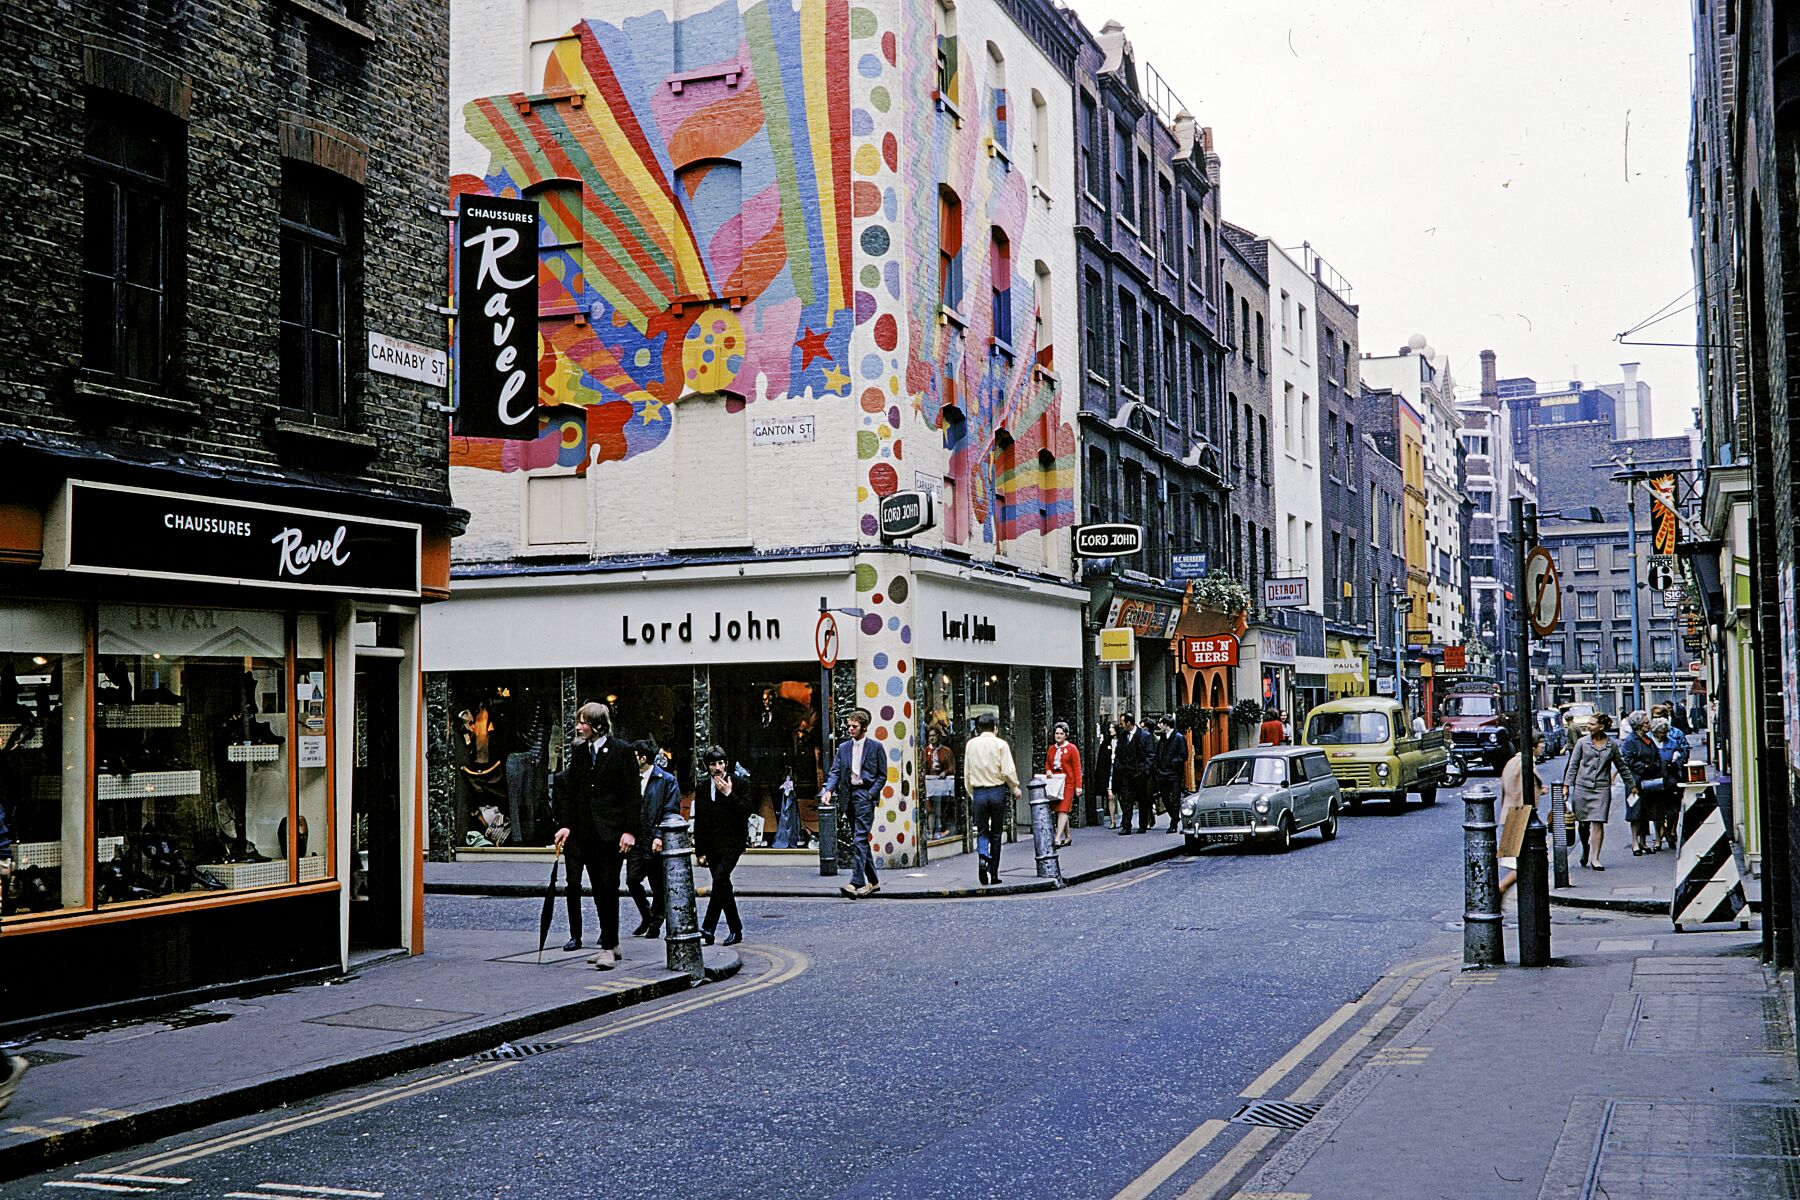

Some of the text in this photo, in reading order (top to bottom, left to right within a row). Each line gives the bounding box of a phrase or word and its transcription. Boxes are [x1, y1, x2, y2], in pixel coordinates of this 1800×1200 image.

[467, 207, 533, 224] CHAUSSURES
[464, 225, 536, 426] Ravel
[371, 343, 426, 371] CARNABY
[755, 424, 795, 437] GANTON
[883, 503, 919, 522] LORD JOHN
[164, 513, 251, 537] CHAUSSURES
[1081, 533, 1136, 547] LORD JOHN
[271, 525, 350, 577] Ravel
[1648, 566, 1673, 590] 6
[1268, 584, 1303, 600] DETROIT
[622, 610, 780, 645] Lord John
[942, 610, 996, 643] Lord John
[1191, 641, 1214, 652] HIS
[1194, 652, 1229, 663] HERS
